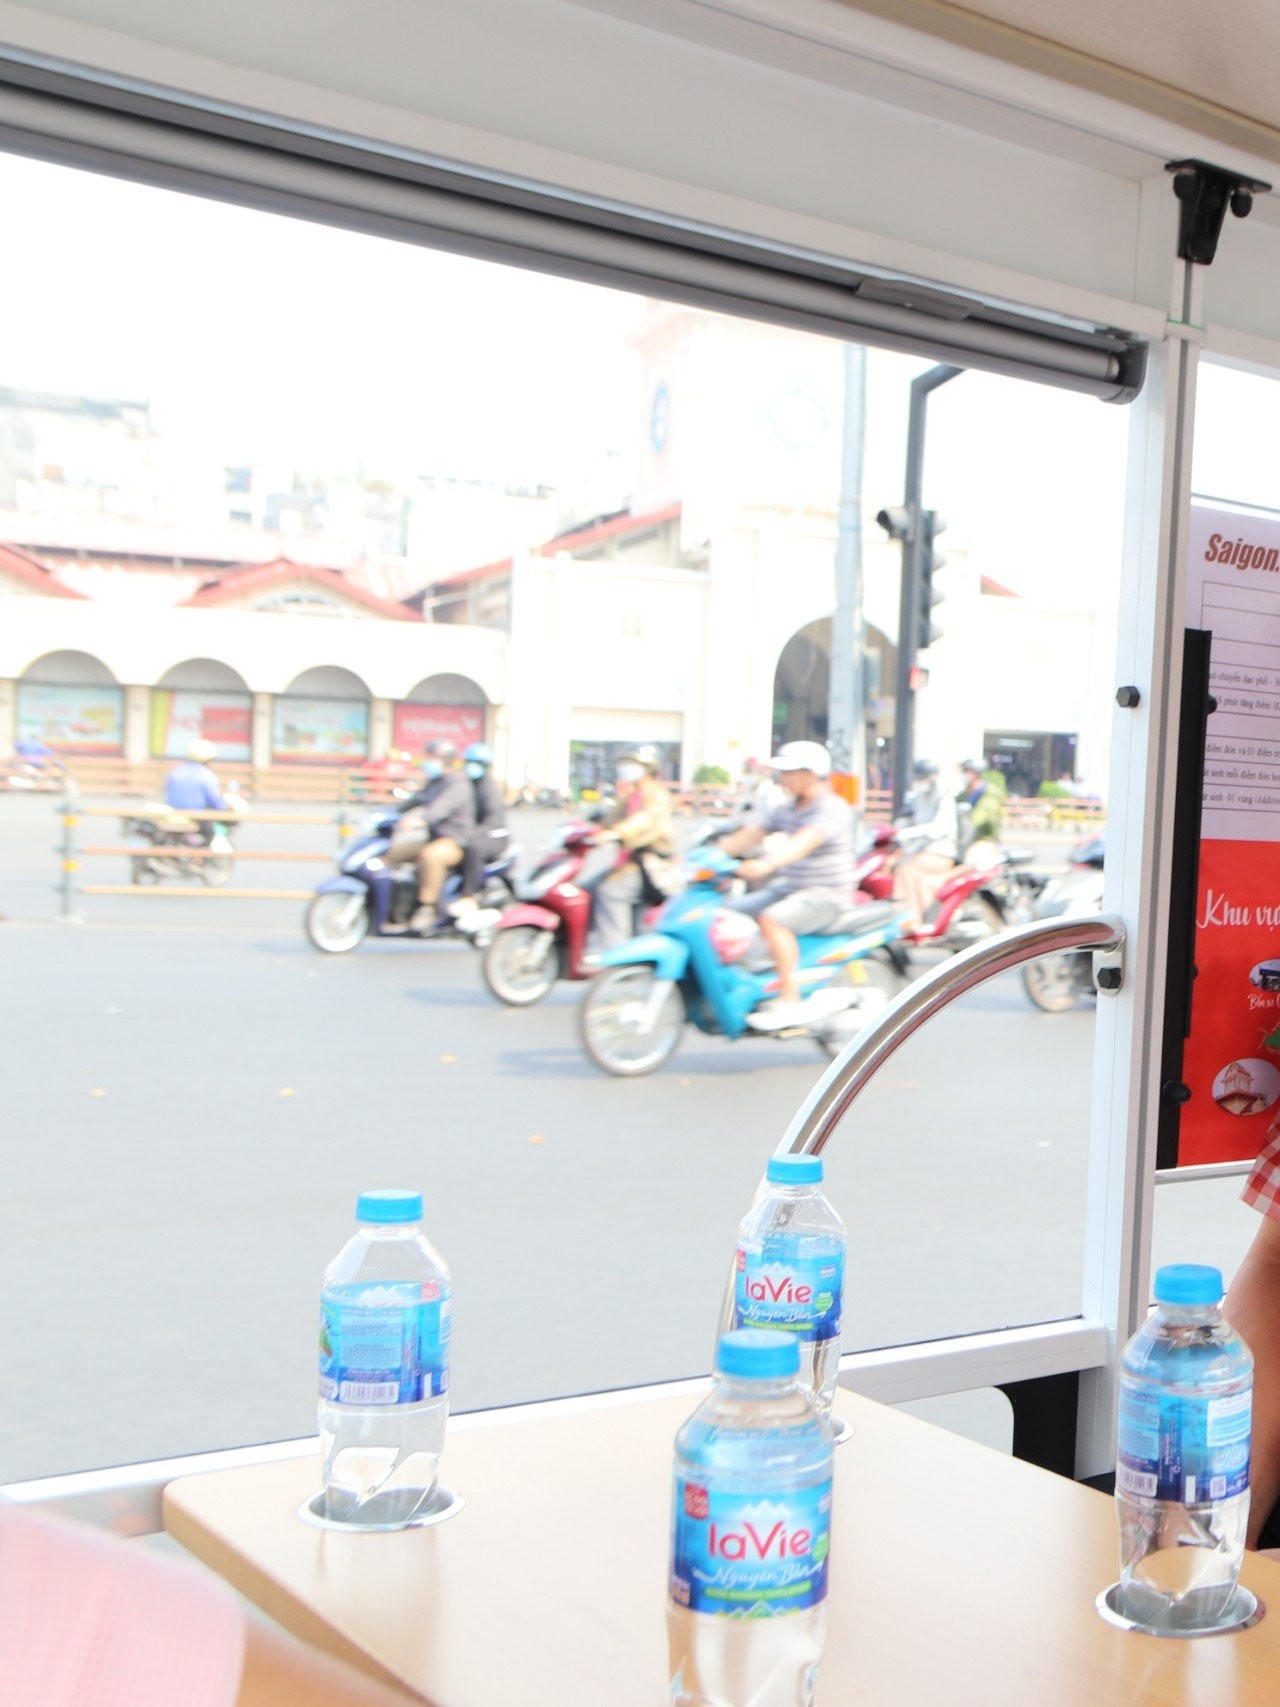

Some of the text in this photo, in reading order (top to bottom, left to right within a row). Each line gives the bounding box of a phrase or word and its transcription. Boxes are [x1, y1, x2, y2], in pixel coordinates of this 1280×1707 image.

[1196, 888, 1251, 929] Khu
[745, 1275, 813, 1304] laVie
[708, 1521, 811, 1561] laVie
